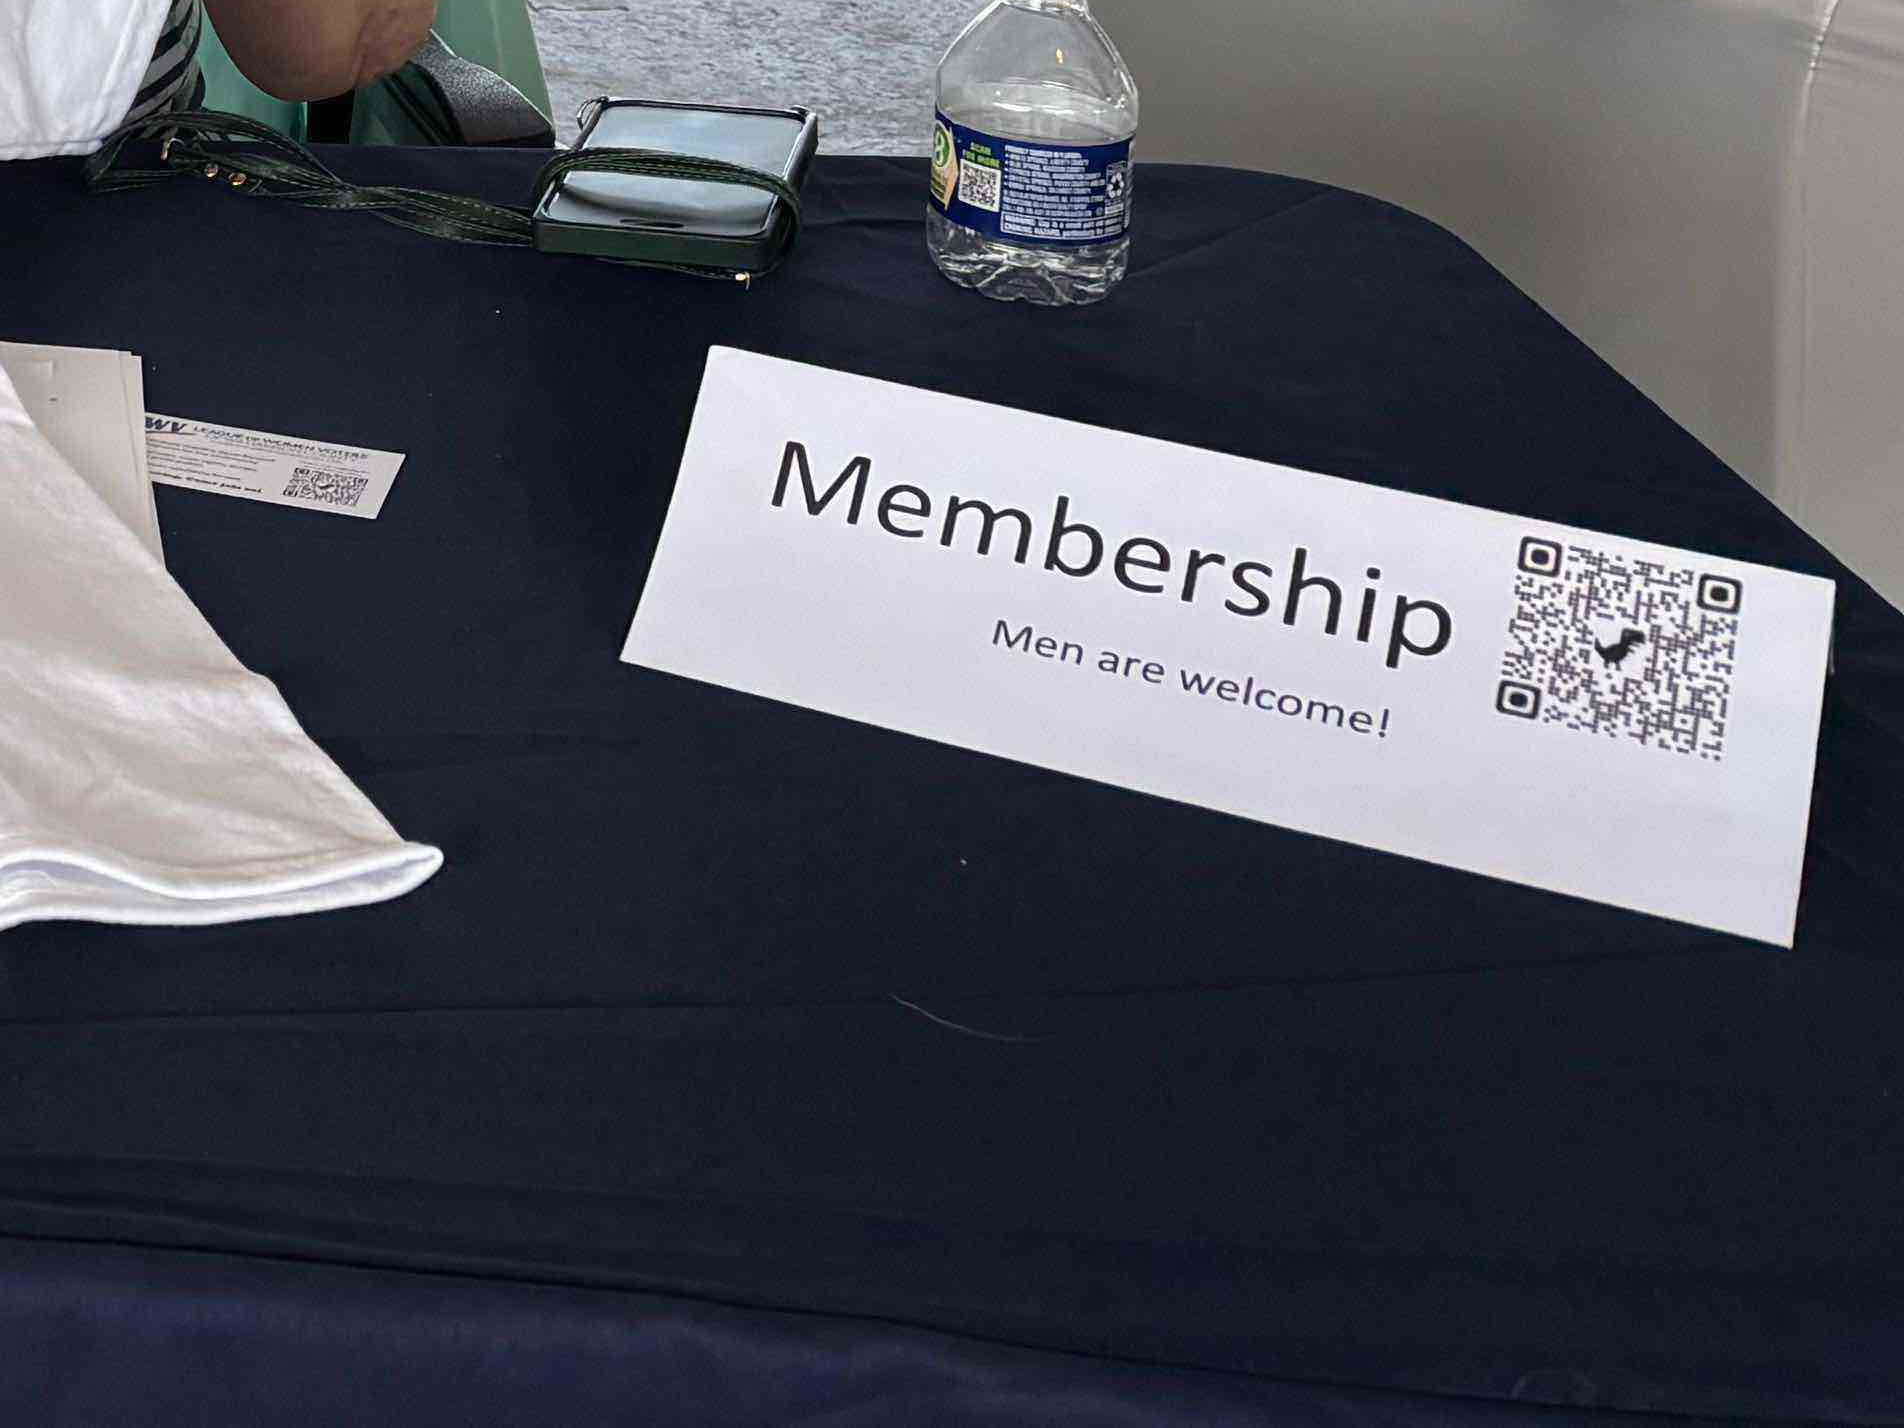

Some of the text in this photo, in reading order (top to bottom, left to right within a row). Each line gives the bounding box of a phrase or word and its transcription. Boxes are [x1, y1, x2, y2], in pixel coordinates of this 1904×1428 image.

[771, 440, 1453, 669] Membership
[991, 618, 1390, 740] Men are welcome!
